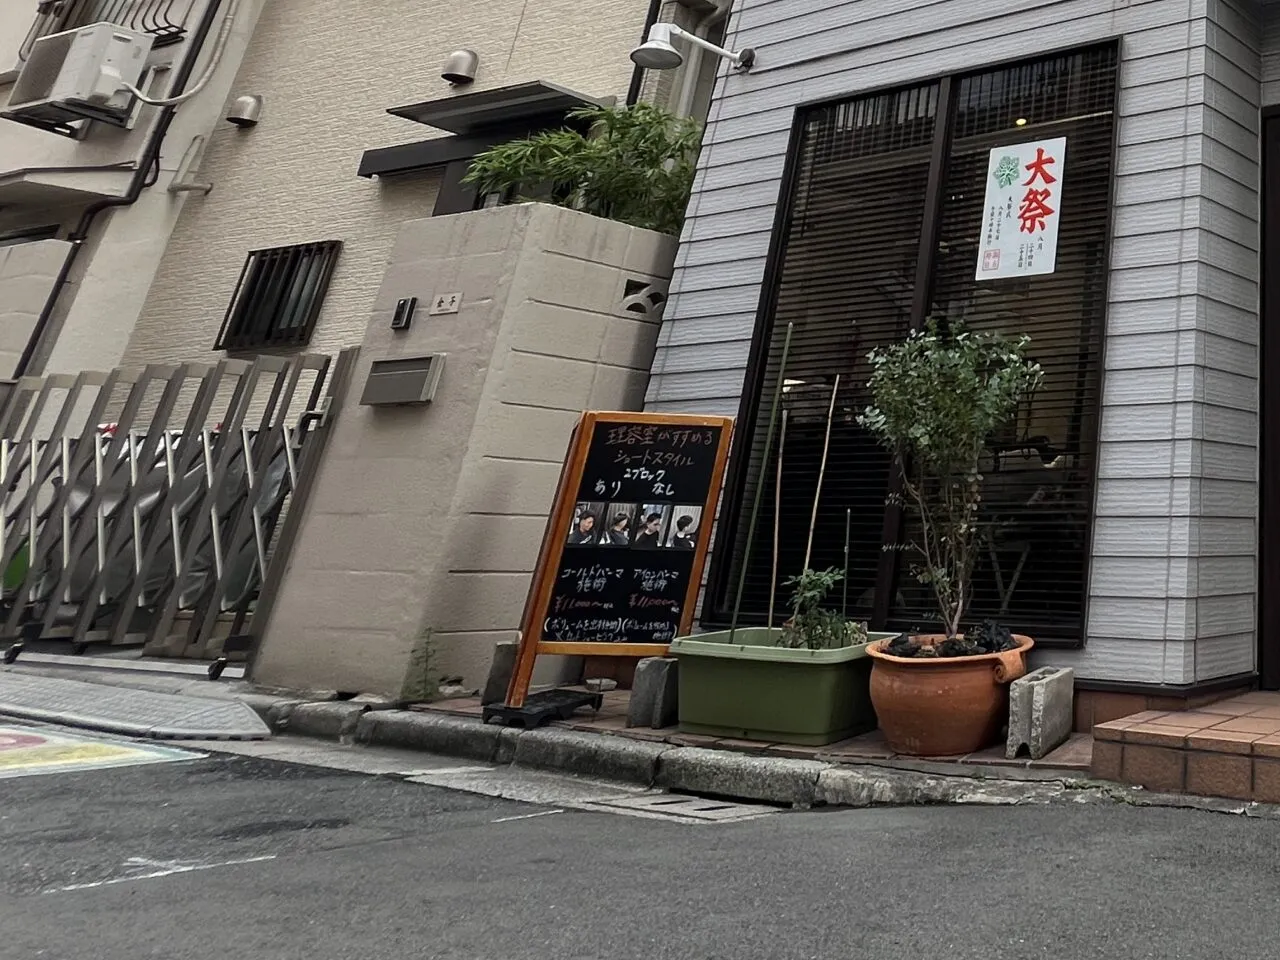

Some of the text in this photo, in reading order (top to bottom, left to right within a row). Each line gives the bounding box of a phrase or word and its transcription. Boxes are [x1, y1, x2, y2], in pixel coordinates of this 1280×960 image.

[1017, 147, 1057, 234] 大祭
[605, 426, 713, 448] 理容室がすすめる
[613, 448, 695, 467] ショートスタイル
[623, 466, 666, 481] 2ブロック
[593, 478, 675, 499] あり なし
